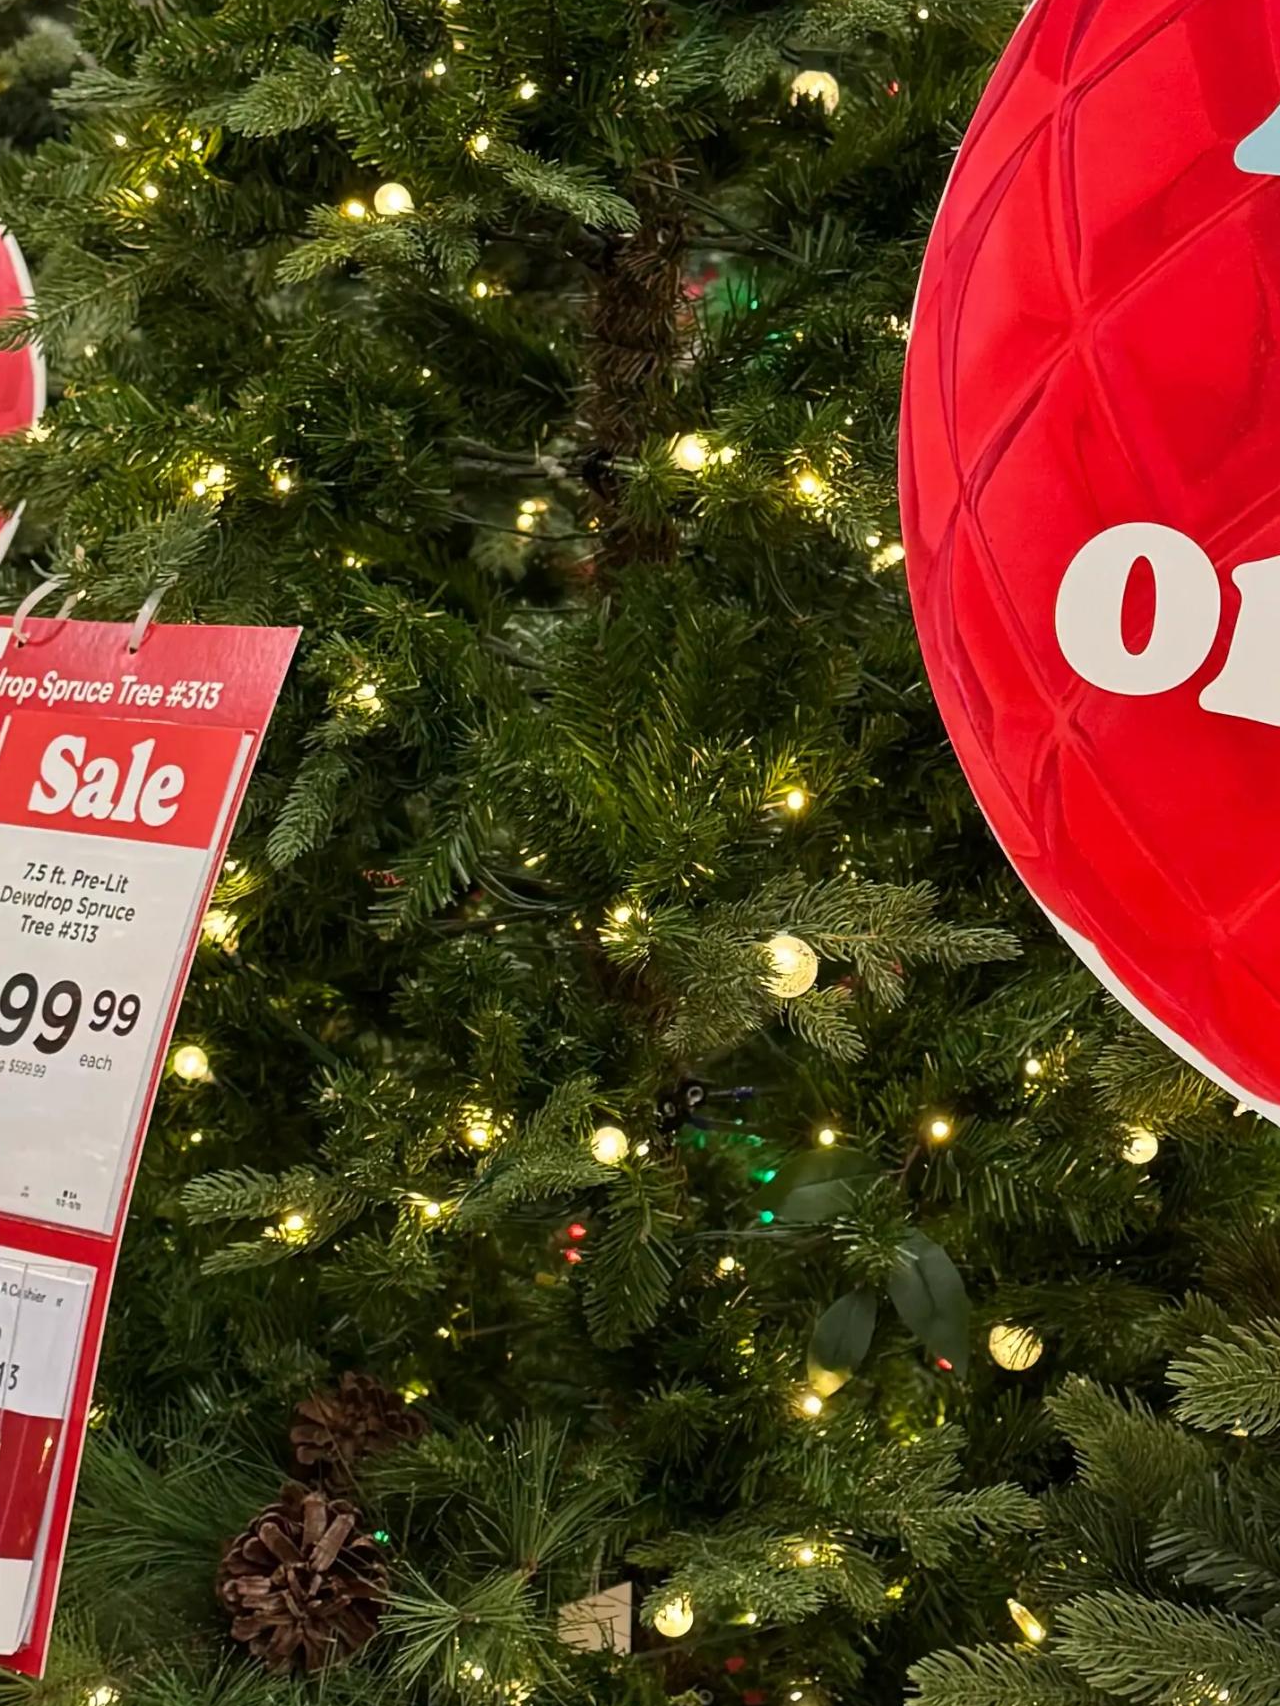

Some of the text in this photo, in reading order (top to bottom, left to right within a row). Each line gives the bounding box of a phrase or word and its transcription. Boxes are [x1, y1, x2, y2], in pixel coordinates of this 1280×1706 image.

[38, 670, 113, 706] Spruce
[118, 675, 169, 707] Tree
[166, 681, 224, 710] #313
[27, 734, 185, 827] Sale
[22, 863, 129, 894] 7.5 ft. Pre-Lit
[0, 885, 135, 922] Dewdrop Spruce
[20, 914, 100, 943] Tree #313
[88, 989, 141, 1037] 99
[79, 1053, 113, 1072] each
[0, 1282, 9, 1294] A
